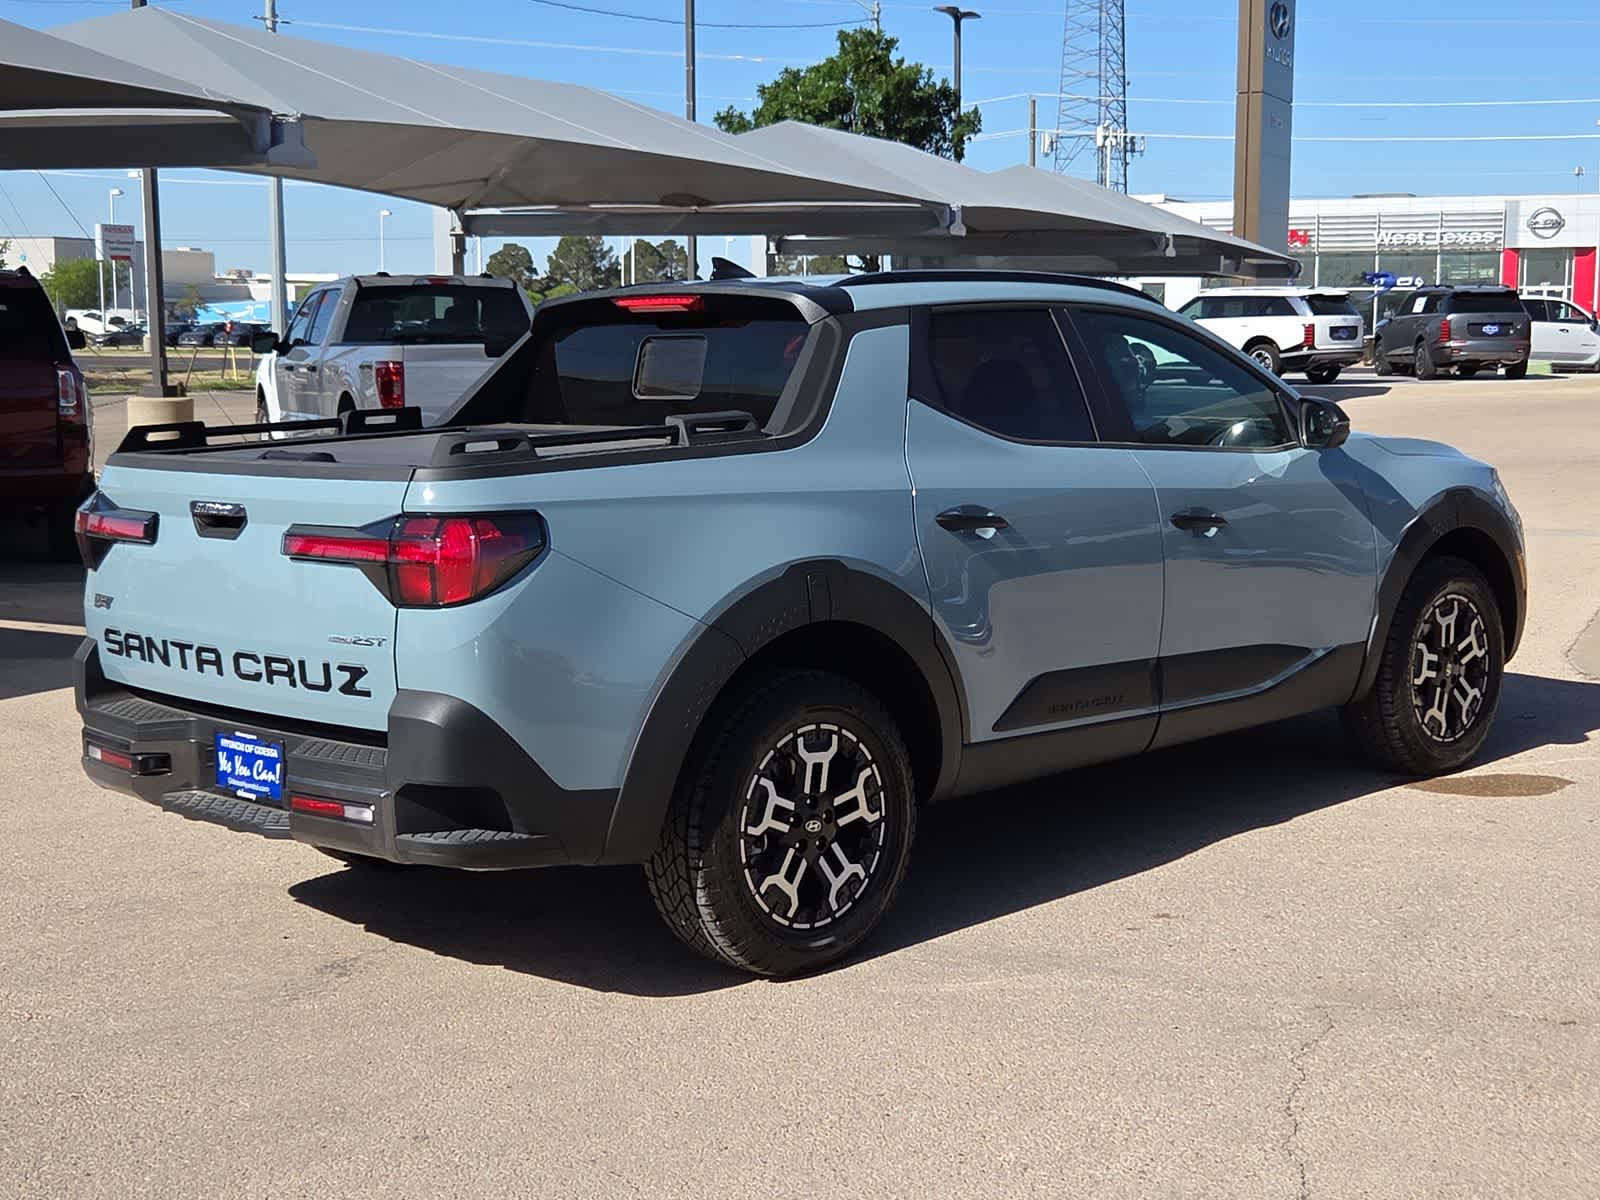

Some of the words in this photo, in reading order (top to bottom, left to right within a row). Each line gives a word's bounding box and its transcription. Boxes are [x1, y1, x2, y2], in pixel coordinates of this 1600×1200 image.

[1374, 230, 1426, 246] West
[1428, 229, 1496, 246] Texas
[104, 627, 225, 677] SANTA
[232, 650, 372, 698] CRUZ
[218, 751, 233, 774] Yes
[234, 754, 251, 777] You
[252, 759, 281, 785] Can!
